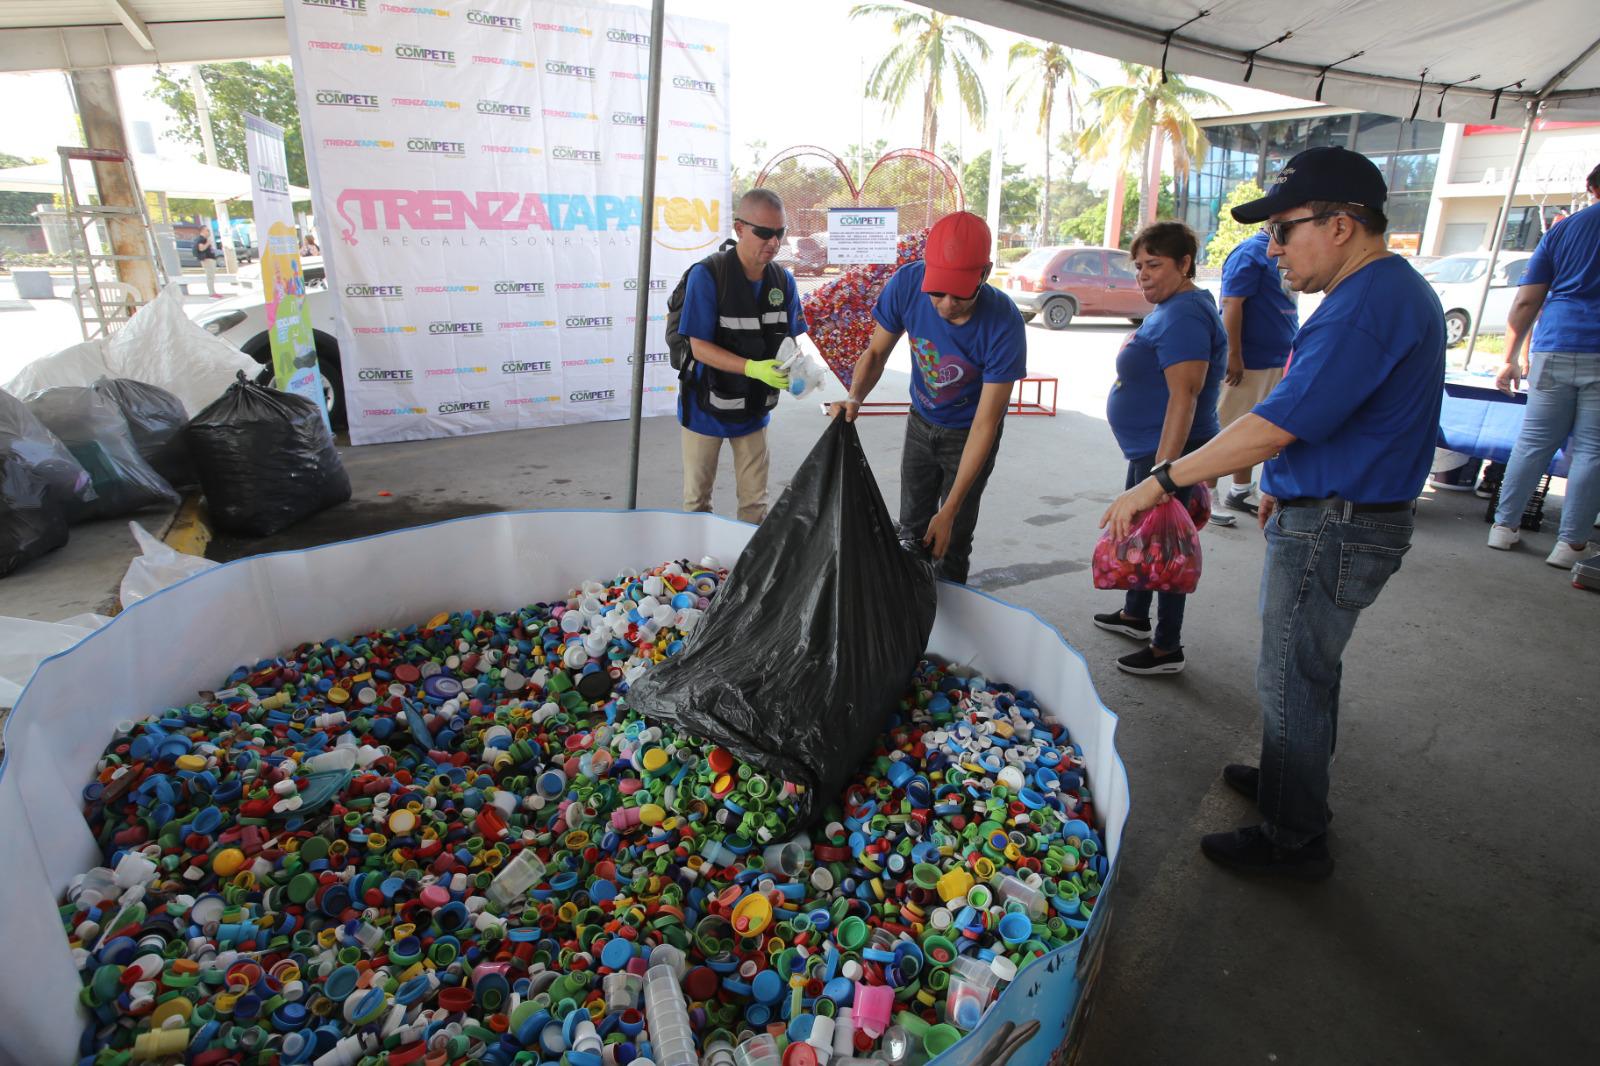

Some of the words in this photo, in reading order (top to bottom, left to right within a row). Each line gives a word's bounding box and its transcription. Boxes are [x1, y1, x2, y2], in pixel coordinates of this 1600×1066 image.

[467, 12, 522, 26] COMPETE
[395, 46, 455, 60] COMPETE
[545, 62, 595, 76] COMPETE
[672, 77, 716, 91] COMPETE
[316, 93, 378, 105] COMPETE
[477, 102, 530, 115] COMPETE
[612, 114, 646, 125] COMPE
[407, 141, 465, 151] COMPETE
[553, 149, 600, 160] COMPETE
[678, 156, 718, 168] COMPETE
[840, 217, 885, 225] COMPETE
[382, 236, 488, 246] REGALA
[512, 236, 632, 246] SONRISAS
[346, 286, 402, 295] COMPETE
[494, 283, 544, 293] COMPETE
[429, 322, 482, 332] COMPETE
[566, 317, 613, 326] COMPETE
[502, 361, 551, 372] COMPETE
[358, 370, 413, 379] COMPETE
[570, 390, 615, 401] COMPETE
[438, 401, 490, 412] COMPETE
